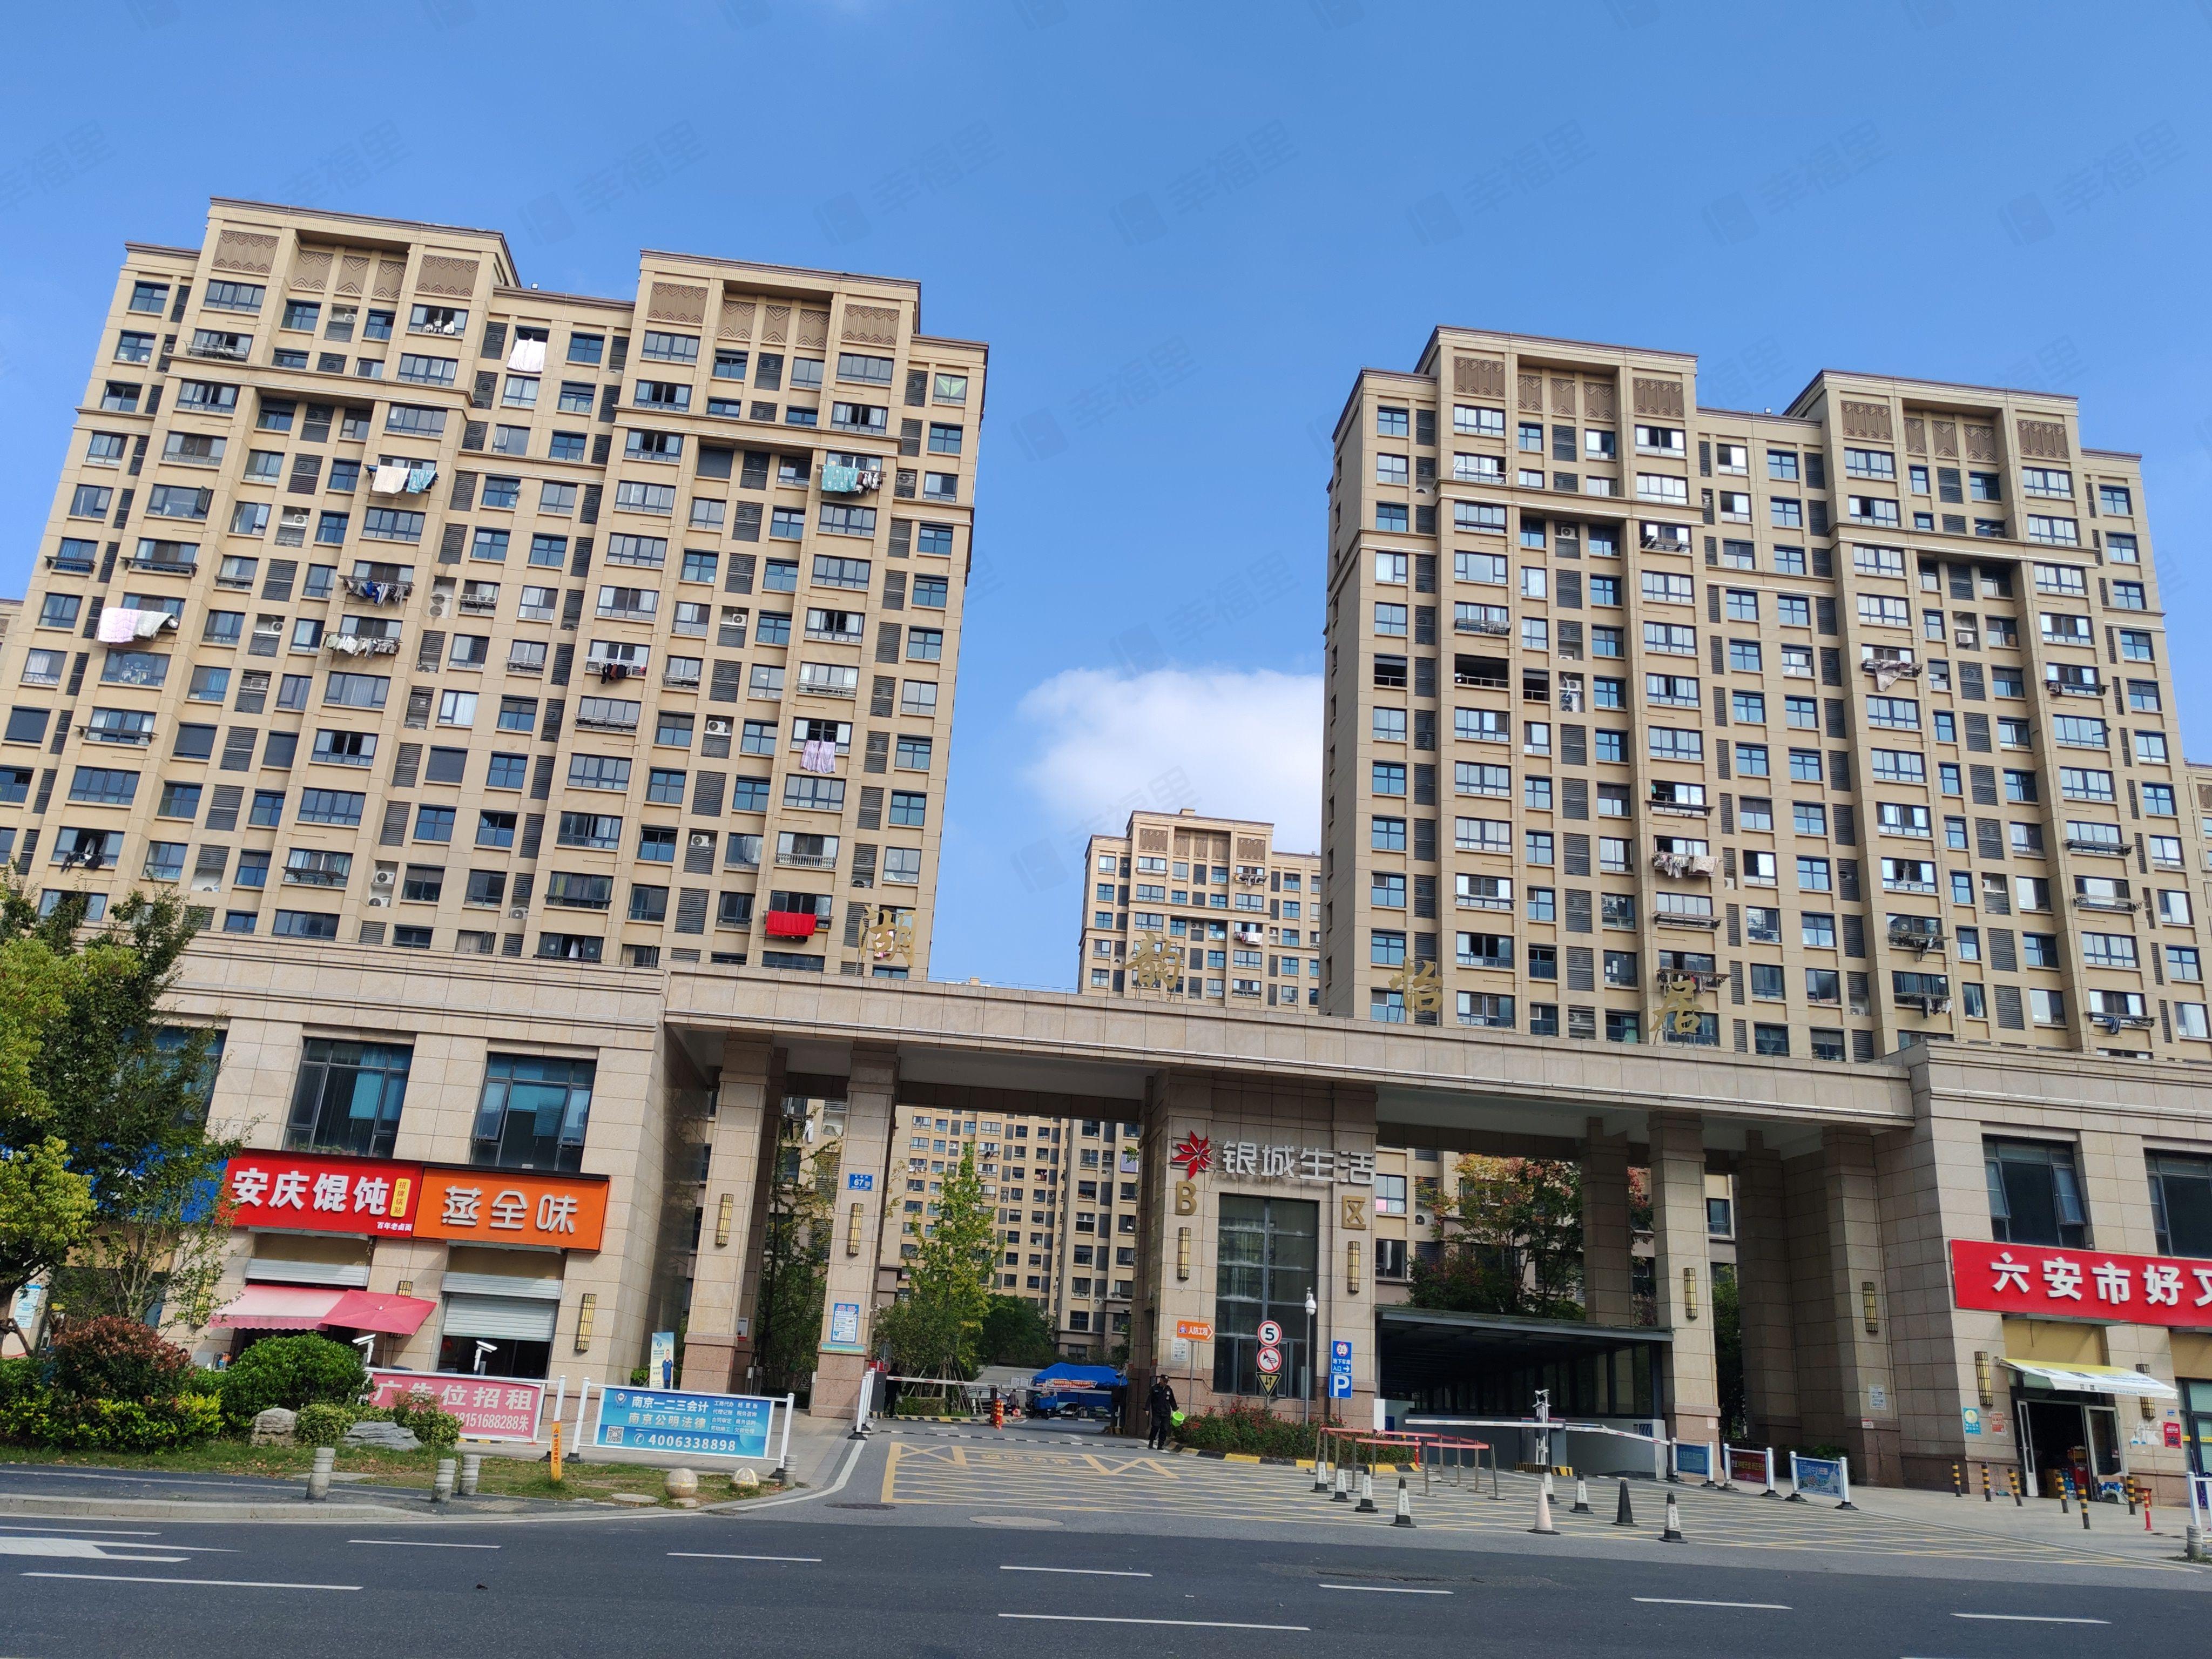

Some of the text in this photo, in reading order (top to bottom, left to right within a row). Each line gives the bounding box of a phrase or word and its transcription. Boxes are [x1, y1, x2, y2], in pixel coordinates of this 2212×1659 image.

[1223, 1141, 1374, 1185] 银城生活
[231, 1167, 389, 1216] 安庆馄饨
[1175, 1181, 1197, 1215] B
[442, 1185, 578, 1233] 蒸全味
[1188, 1326, 1208, 1336] 人防工程
[1265, 1328, 1274, 1341] 5
[1334, 1375, 1350, 1397] P
[631, 1395, 709, 1413] 南京一二三会计
[628, 1412, 707, 1430] 南京公明法律
[648, 1434, 736, 1452] 4006338898
